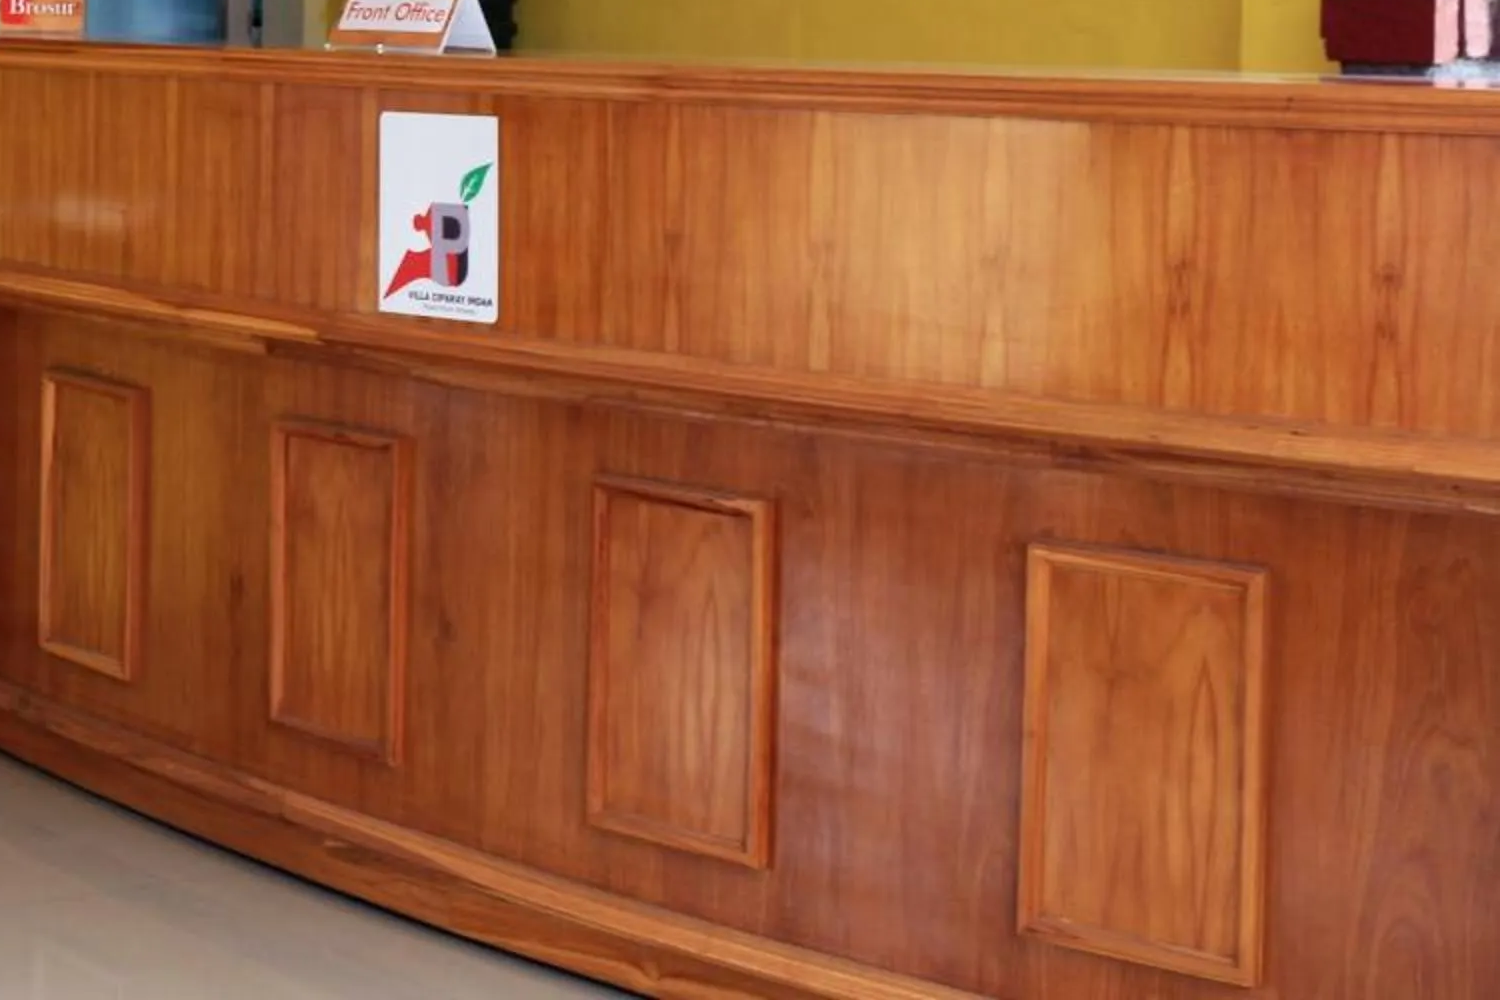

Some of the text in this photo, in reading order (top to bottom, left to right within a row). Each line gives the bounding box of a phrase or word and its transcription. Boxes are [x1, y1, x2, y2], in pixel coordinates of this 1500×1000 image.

[346, 1, 447, 23] Front Office
[408, 291, 430, 301] VILLA
